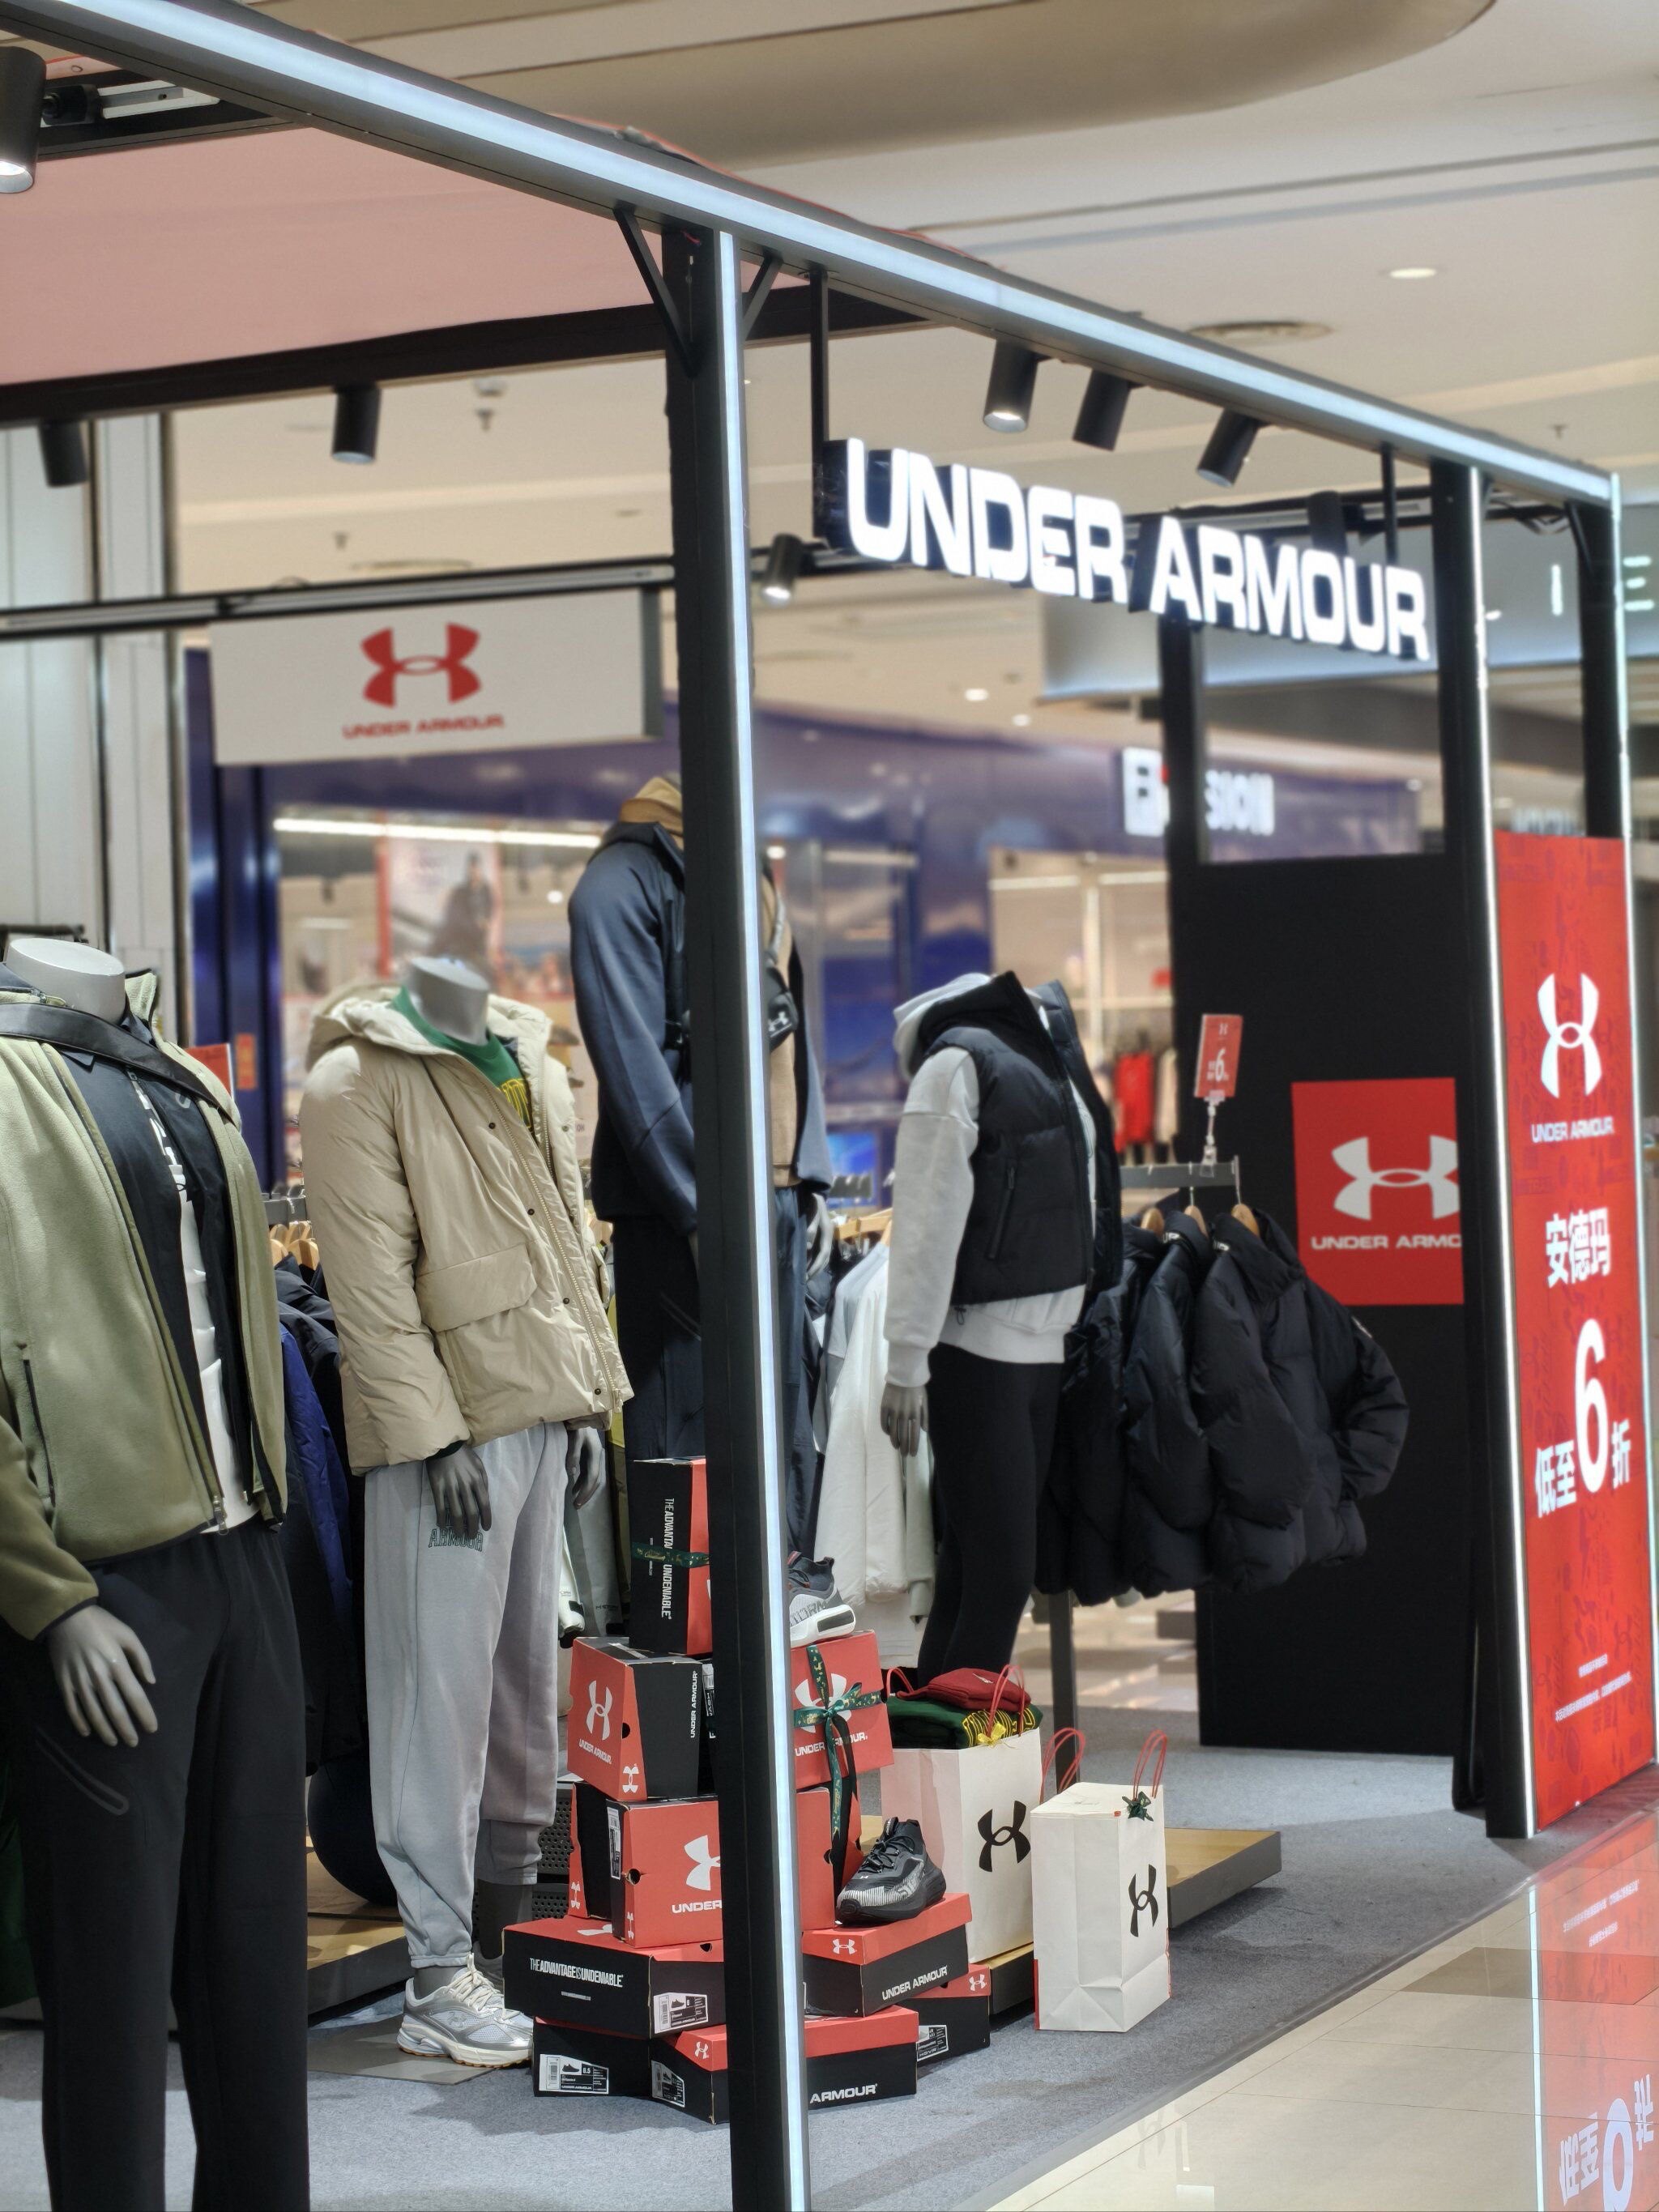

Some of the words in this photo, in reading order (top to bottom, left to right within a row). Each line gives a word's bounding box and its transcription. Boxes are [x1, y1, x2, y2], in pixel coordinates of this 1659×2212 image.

[847, 437, 1128, 605] UNDER
[1149, 515, 1430, 662] ARMOUR
[342, 720, 411, 739] UNDER
[416, 714, 505, 735] ARMOUR
[1531, 1122, 1569, 1144] UNDER
[1570, 1115, 1615, 1139] ARMOUR
[1311, 1235, 1389, 1250] UNDER
[1546, 1207, 1611, 1289] 安德玛
[579, 1738, 593, 1754] UNDER
[593, 1748, 612, 1764] ARMOUR
[795, 1741, 825, 1757] UNDER
[672, 1899, 723, 1914] UNDER
[882, 1981, 911, 2001] UNDER
[912, 1967, 947, 1989] ARMOUR
[810, 2084, 877, 2104] ARMOUR
